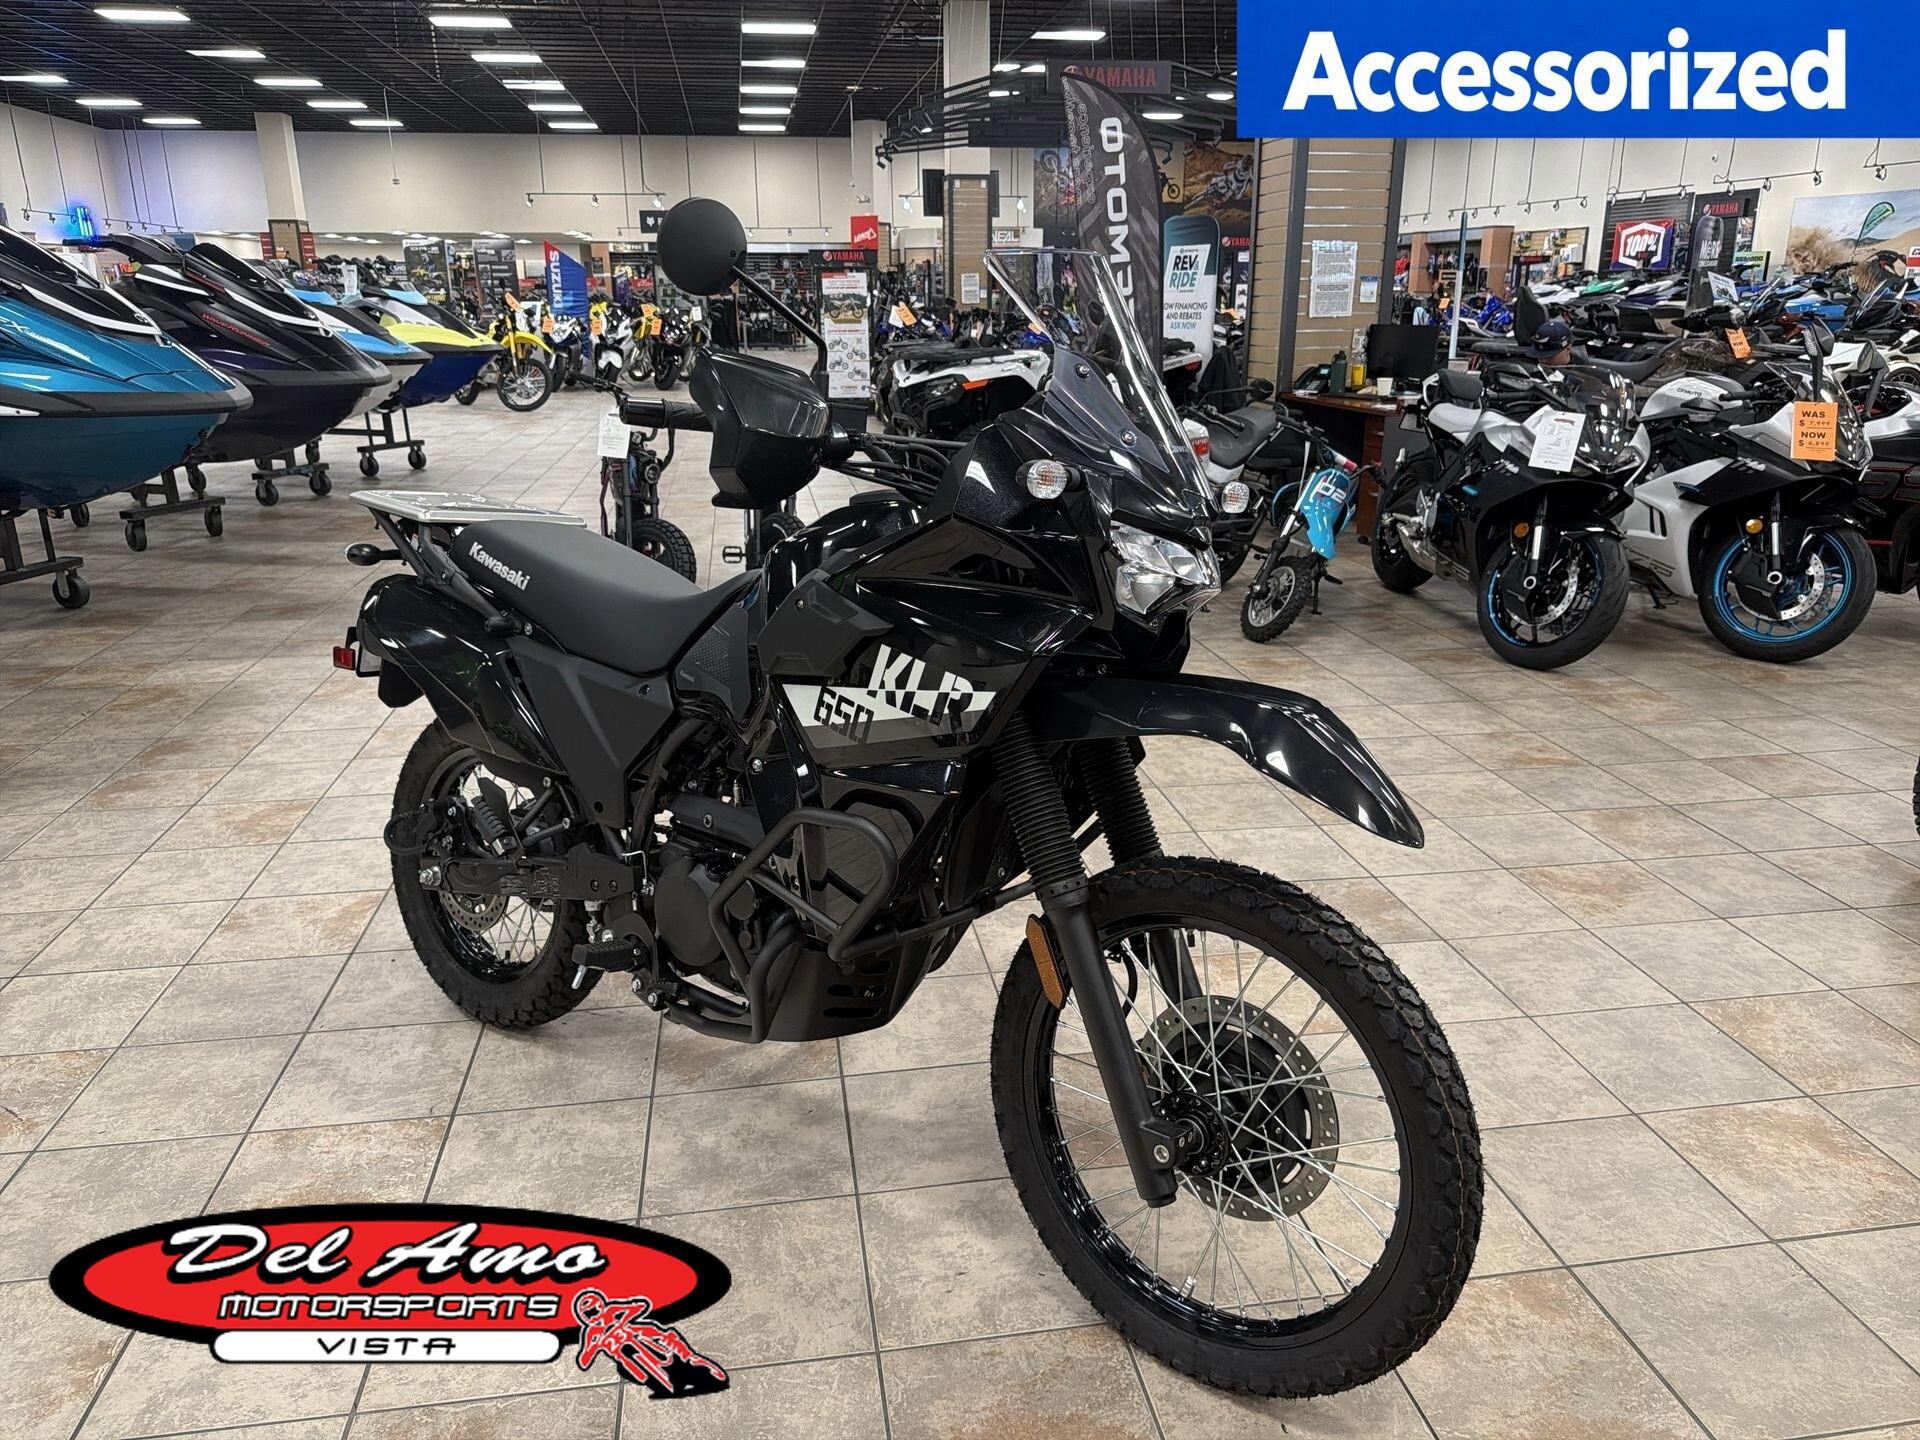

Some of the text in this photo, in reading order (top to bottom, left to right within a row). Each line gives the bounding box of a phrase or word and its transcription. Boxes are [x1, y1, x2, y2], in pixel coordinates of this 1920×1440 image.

[1084, 66, 1157, 87] YAMAHA
[1711, 203, 1738, 214] YAMAHA
[1231, 237, 1250, 246] YAMA
[1626, 234, 1660, 257] 100%
[832, 251, 865, 261] YAMAHA
[1173, 254, 1199, 272] REV
[550, 250, 564, 309] SUZUKI
[1169, 271, 1198, 291] RIDE
[1175, 302, 1208, 311] FINANCING
[1166, 311, 1202, 320] AND REBATES
[1170, 321, 1198, 330] ASK NOW
[1802, 410, 1826, 419] WAS
[1799, 419, 1805, 427] $
[1801, 431, 1827, 439] NOW
[1798, 439, 1805, 447] $
[468, 541, 531, 591] Kawasaki
[867, 643, 974, 732] KLR
[814, 685, 875, 745] 650
